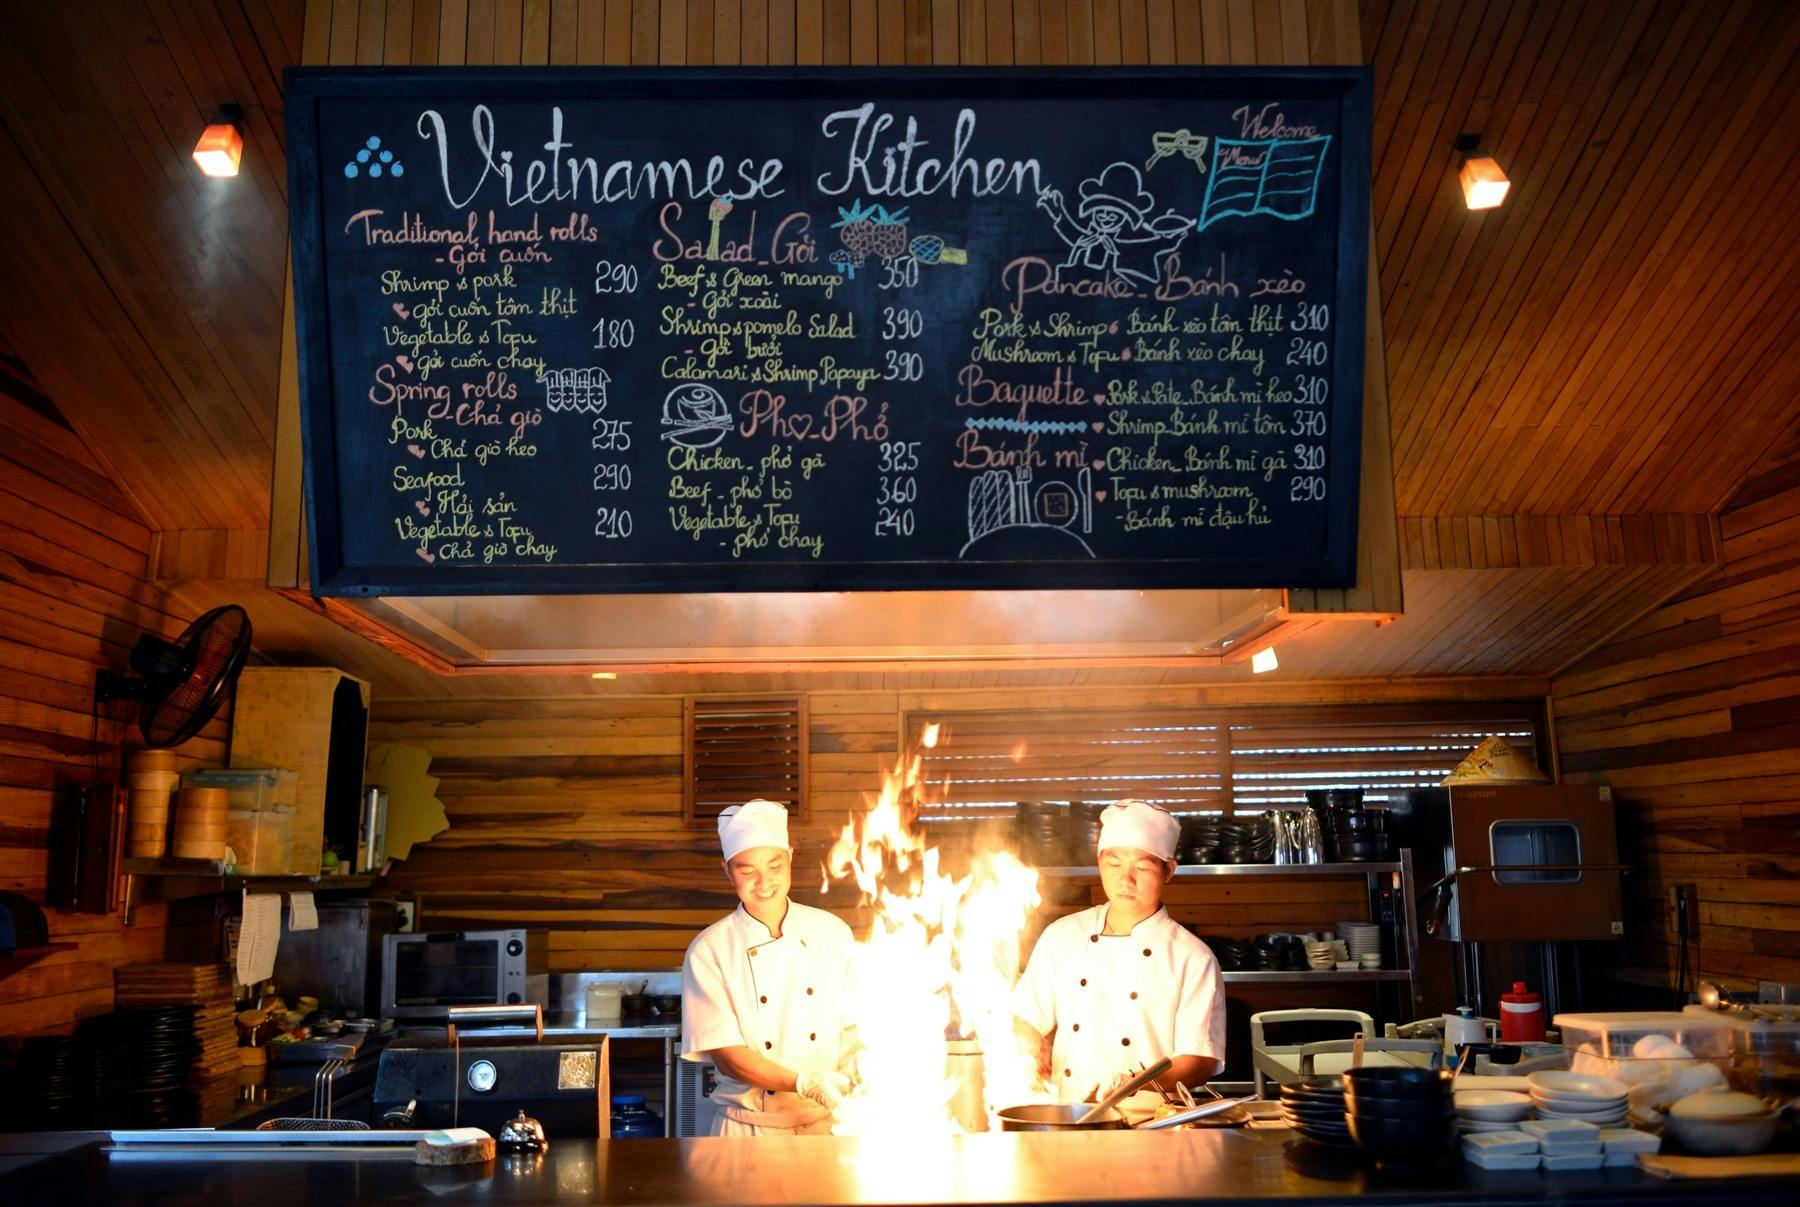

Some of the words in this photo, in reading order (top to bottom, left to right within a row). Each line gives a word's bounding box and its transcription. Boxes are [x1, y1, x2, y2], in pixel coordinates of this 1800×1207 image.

[1231, 101, 1322, 139] Welcome
[417, 103, 785, 209] Vietnamese
[816, 102, 1044, 198] Kitchen
[344, 208, 479, 246] Traditional
[488, 208, 544, 244] hand
[550, 210, 599, 243] rolls
[380, 269, 450, 302] Shrimp
[472, 264, 518, 299] pork
[595, 260, 639, 295] 290
[657, 263, 706, 298] Beef
[722, 266, 773, 298] Green
[780, 270, 843, 300] mango
[877, 255, 920, 290] 350
[1001, 255, 1135, 315] Pancake
[495, 292, 534, 316] tôm
[538, 286, 578, 319] thịt
[1289, 301, 1330, 333] 310
[383, 319, 474, 358] Vegetable
[592, 317, 635, 350] 180
[743, 309, 803, 347] pomelo
[882, 306, 924, 340] 390
[972, 307, 1028, 341] Pork
[1042, 311, 1109, 349] Shrimp
[1209, 302, 1245, 335] tôm
[496, 347, 547, 377] chay
[883, 349, 925, 383] 390
[970, 338, 1065, 365] Mushroom
[1216, 334, 1267, 377] chay
[1285, 336, 1329, 367] 240
[660, 354, 750, 381] Calamari
[762, 358, 819, 393] Shrimp
[819, 355, 881, 391] Papaya
[1265, 375, 1293, 403] heo
[1292, 373, 1329, 406] 310
[367, 363, 451, 419] Spring
[461, 370, 518, 401] rolls
[954, 363, 1090, 425] Baguette
[388, 414, 438, 445] Pork
[590, 417, 633, 451] 275
[1105, 409, 1168, 448] Shrimp
[1253, 405, 1288, 435] tôm
[1289, 408, 1328, 437] 370
[504, 436, 538, 458] heo
[667, 444, 746, 472] Chicken
[877, 441, 923, 472] 325
[1105, 445, 1175, 473] Chicken
[1292, 442, 1326, 471] 310
[392, 462, 466, 502] Seafood
[592, 462, 633, 492] 290
[668, 474, 714, 508] Beef
[875, 475, 919, 506] 360
[1290, 474, 1328, 502] 290
[394, 511, 482, 549] Vegetable
[594, 506, 634, 539] 210
[668, 503, 752, 542] Vegetable
[874, 506, 917, 538] 240
[514, 535, 559, 563] chay
[777, 524, 826, 558] chay
